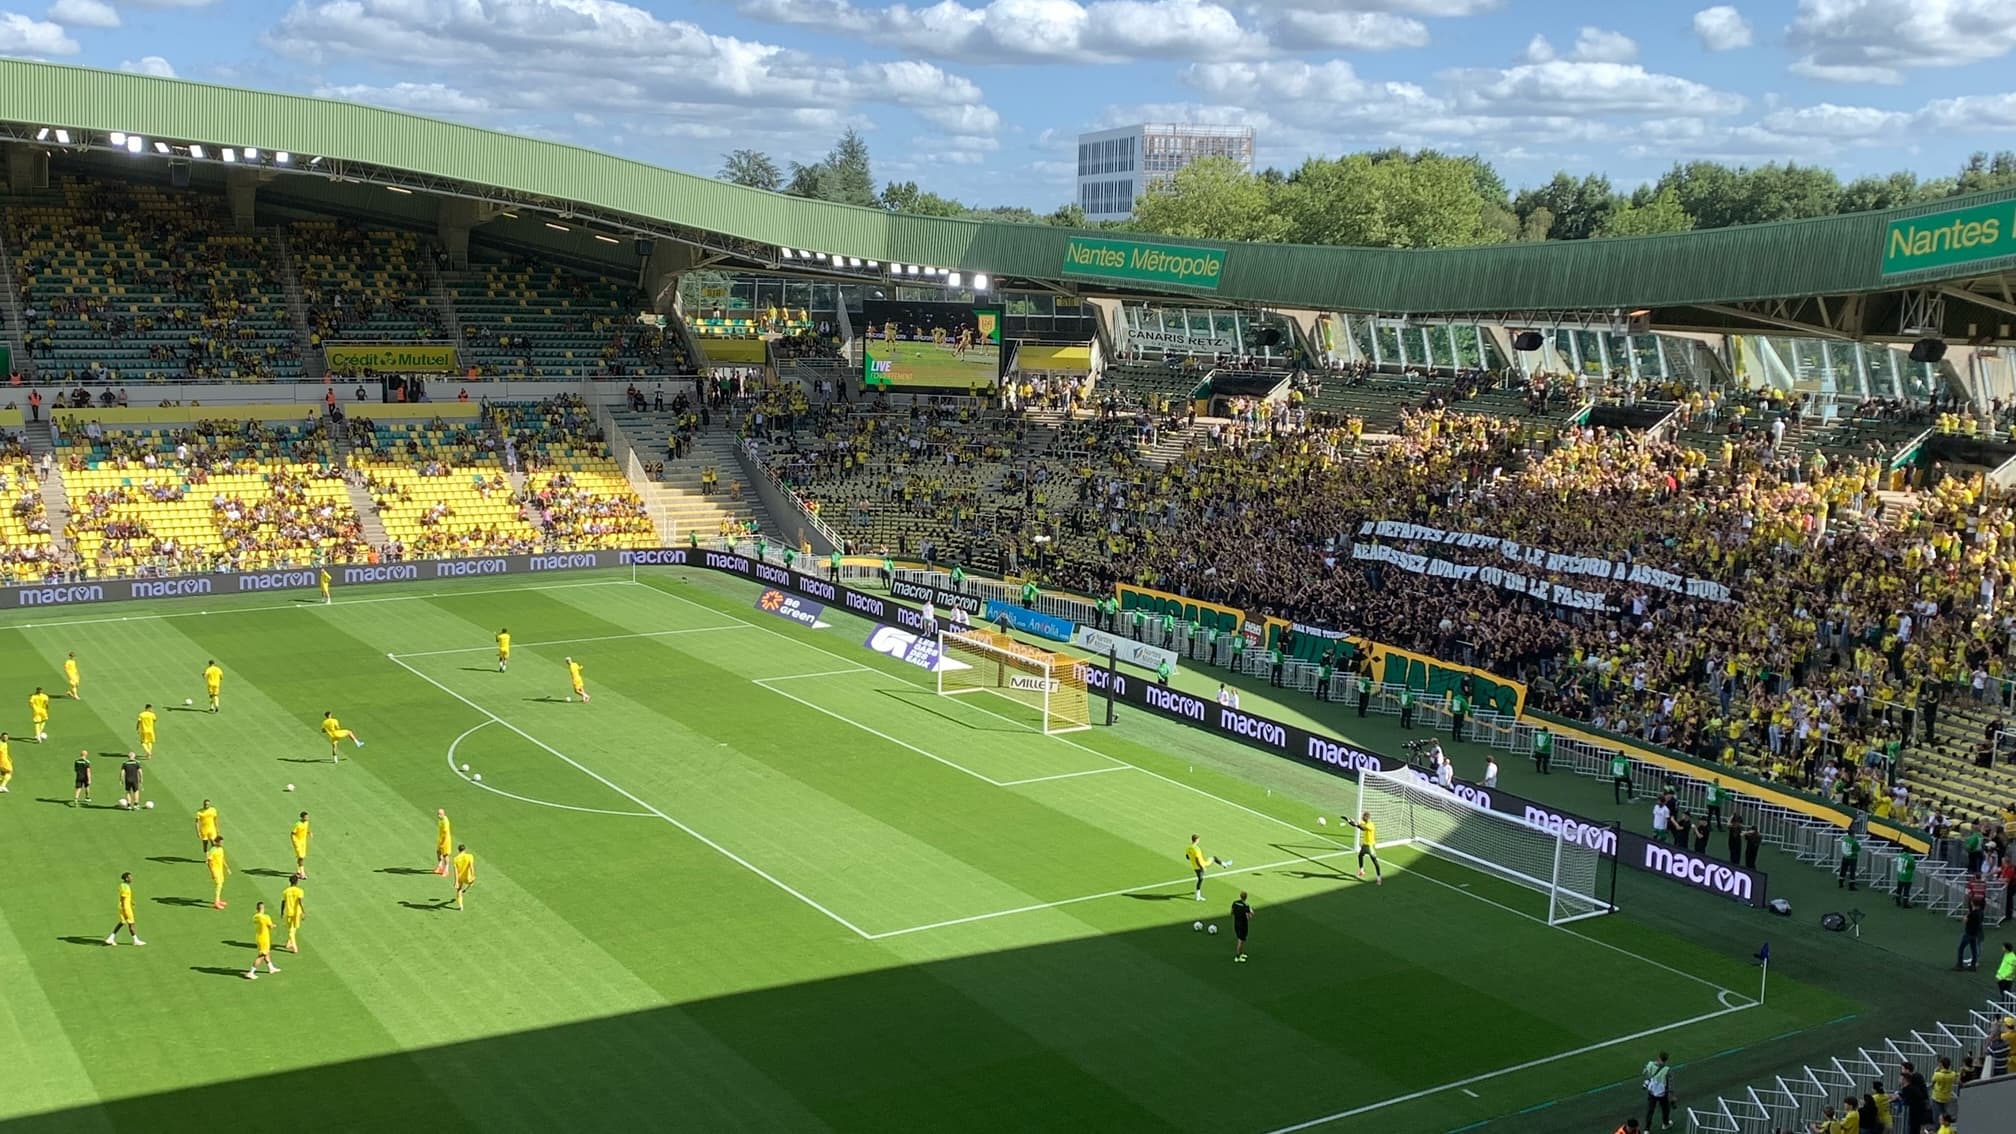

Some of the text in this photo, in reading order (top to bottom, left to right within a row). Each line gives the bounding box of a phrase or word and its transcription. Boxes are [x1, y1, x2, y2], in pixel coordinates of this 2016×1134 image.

[1889, 218, 2000, 259] Nantes
[1067, 242, 1220, 279] Nantes Métropole
[1128, 329, 1185, 344] CANARIS
[332, 353, 448, 366] Crédit Mutuel
[871, 360, 892, 371] LIVE
[437, 557, 506, 577] macron
[530, 553, 595, 570] macron
[619, 550, 686, 565] macron
[706, 552, 748, 573] macron
[1376, 520, 1446, 541] DEFAITES
[1524, 547, 1546, 567] LE
[1547, 553, 1611, 578] RECORD
[1613, 562, 1627, 580] A
[1627, 565, 1683, 593] ASSEZ
[239, 570, 315, 590] macron
[345, 563, 417, 583] macron
[756, 564, 790, 586] macron
[1352, 543, 1428, 573] REAGISSEZ
[1427, 558, 1479, 580] AVANT
[1529, 580, 1550, 600] LE
[19, 585, 103, 605] macron
[131, 578, 211, 597] macron
[800, 577, 834, 600] macron
[893, 579, 933, 602] macron
[846, 591, 883, 617] macron
[919, 637, 936, 648] LES
[910, 650, 928, 660] DES
[1146, 685, 1205, 721] macron
[1221, 708, 1285, 747] macron
[1308, 738, 1381, 772] macron
[1525, 806, 1617, 856] macron
[1646, 844, 1752, 899] macron
